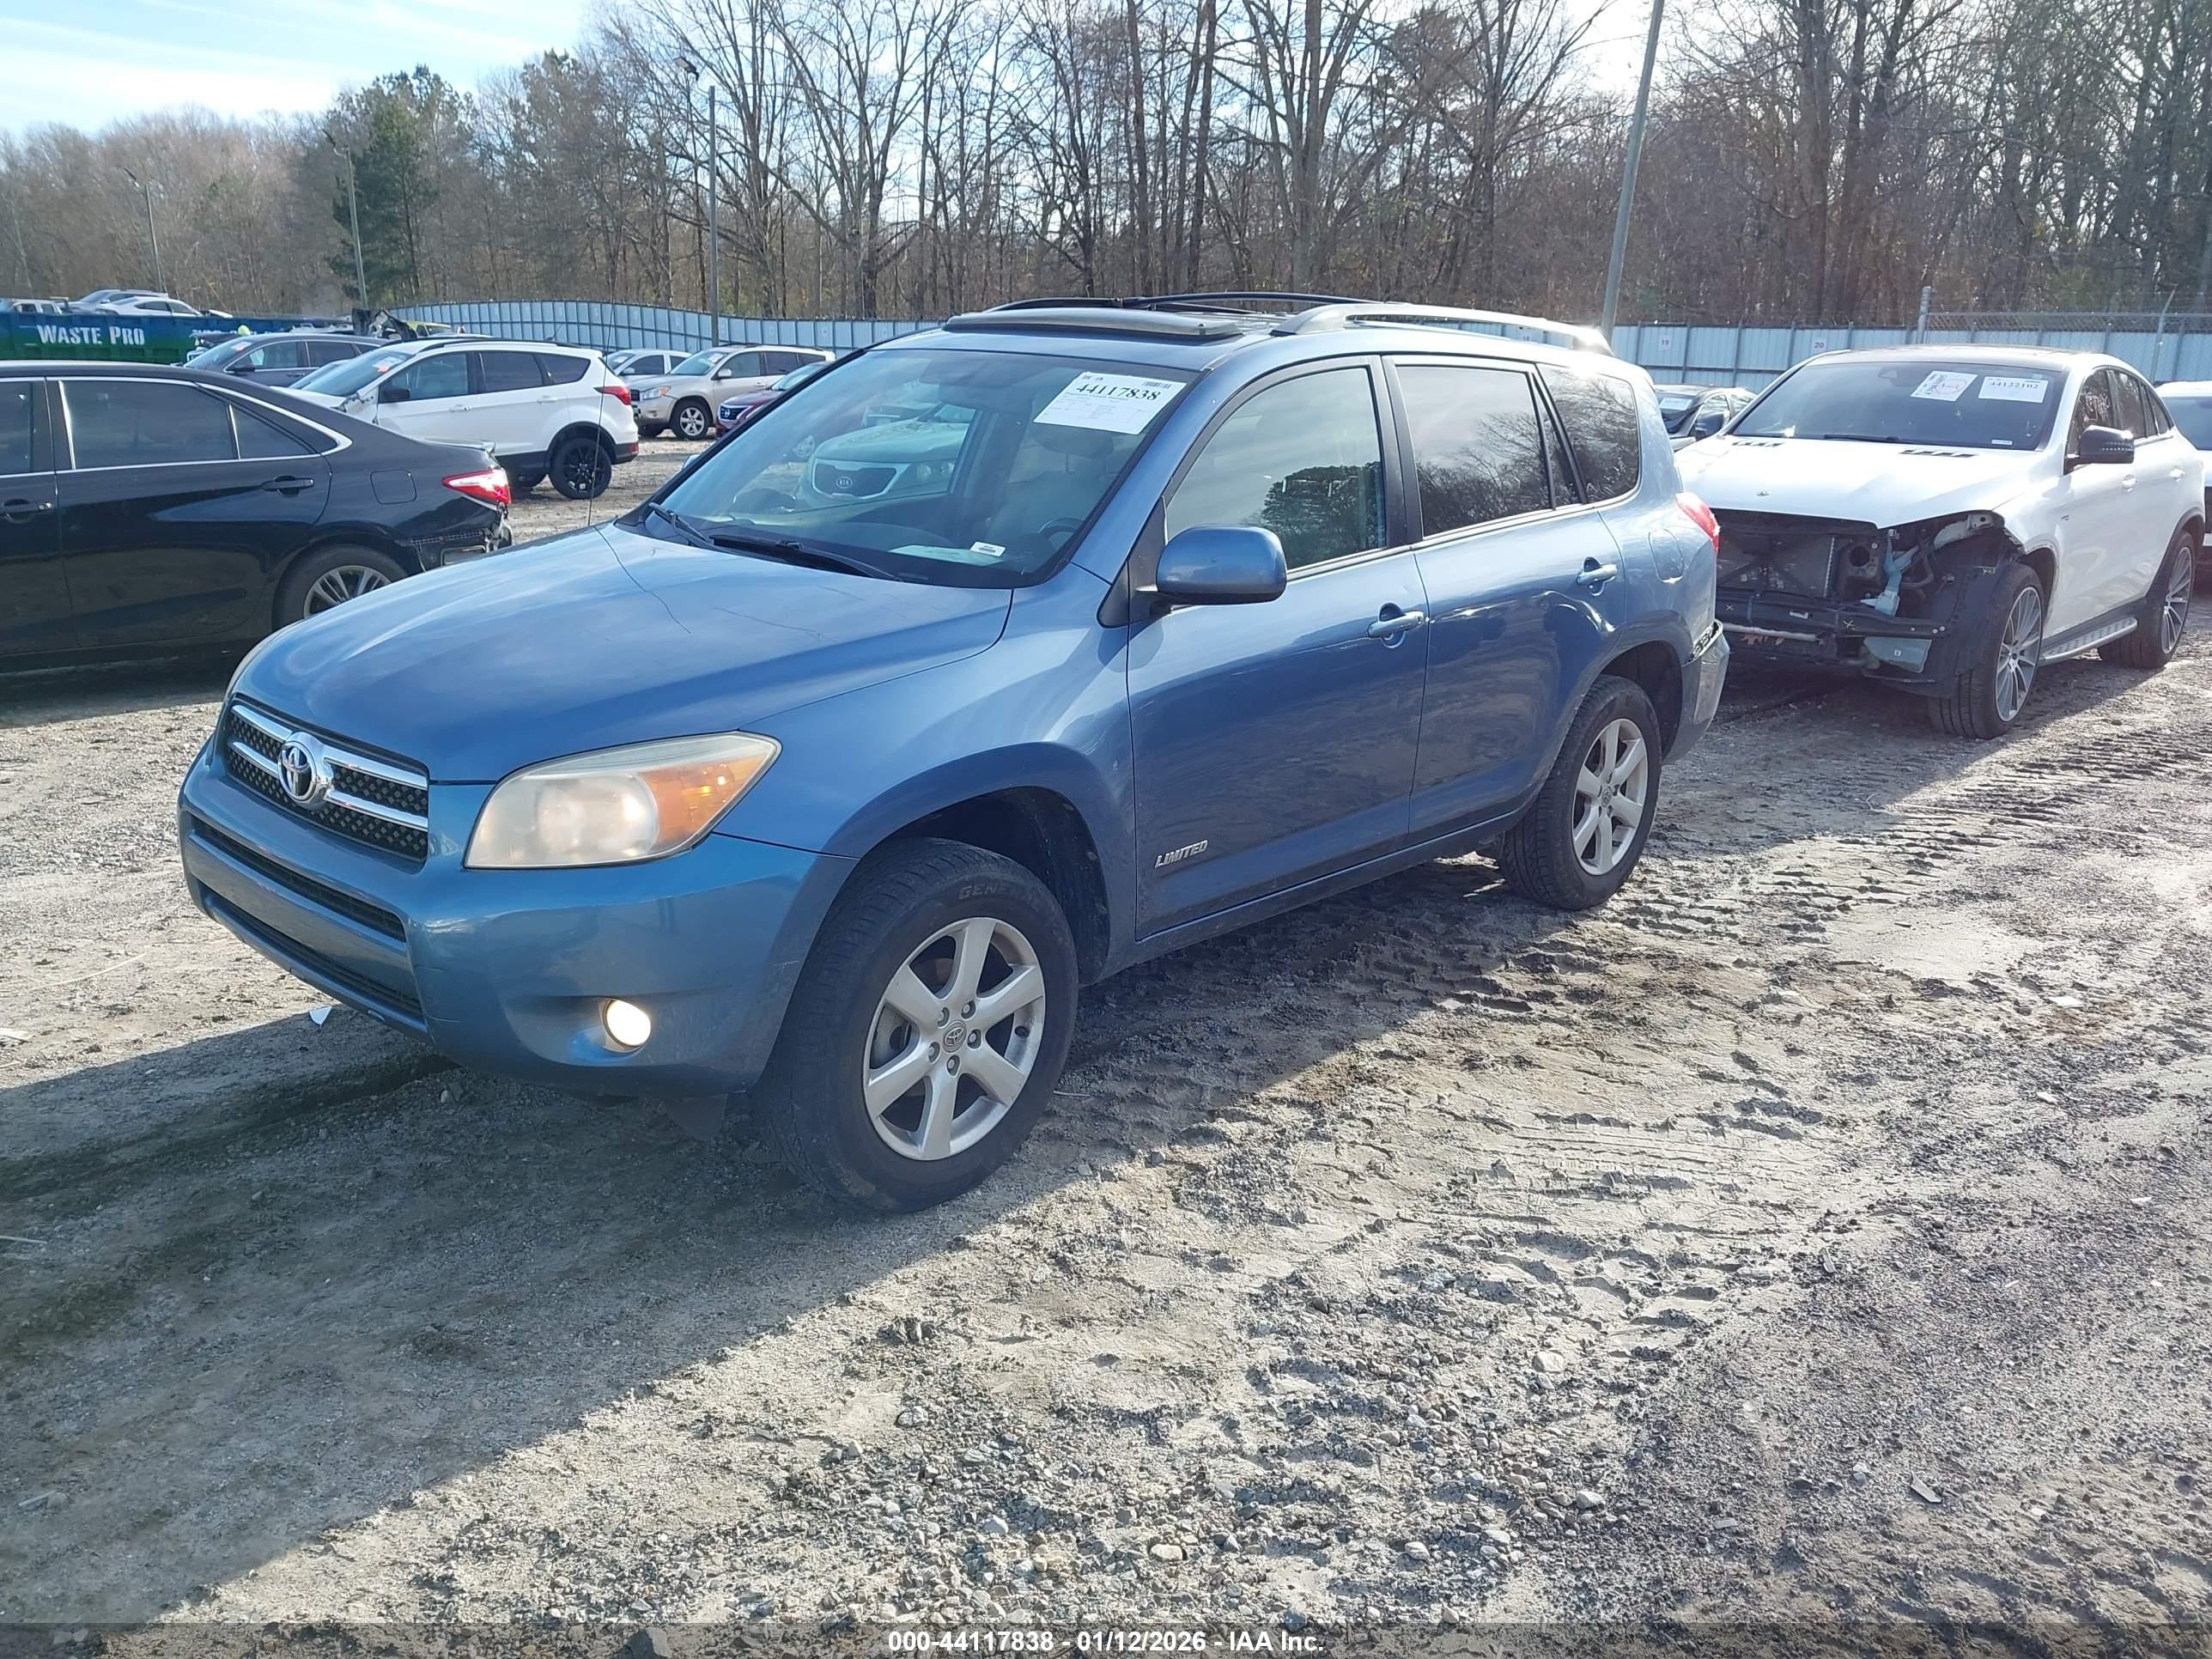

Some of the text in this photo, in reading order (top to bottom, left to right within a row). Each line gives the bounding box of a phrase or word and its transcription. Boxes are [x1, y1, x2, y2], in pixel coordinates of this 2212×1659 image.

[36, 325, 145, 345] WASTE PRO
[1076, 383, 1161, 400] 44117838
[1154, 840, 1208, 868] LIMITED
